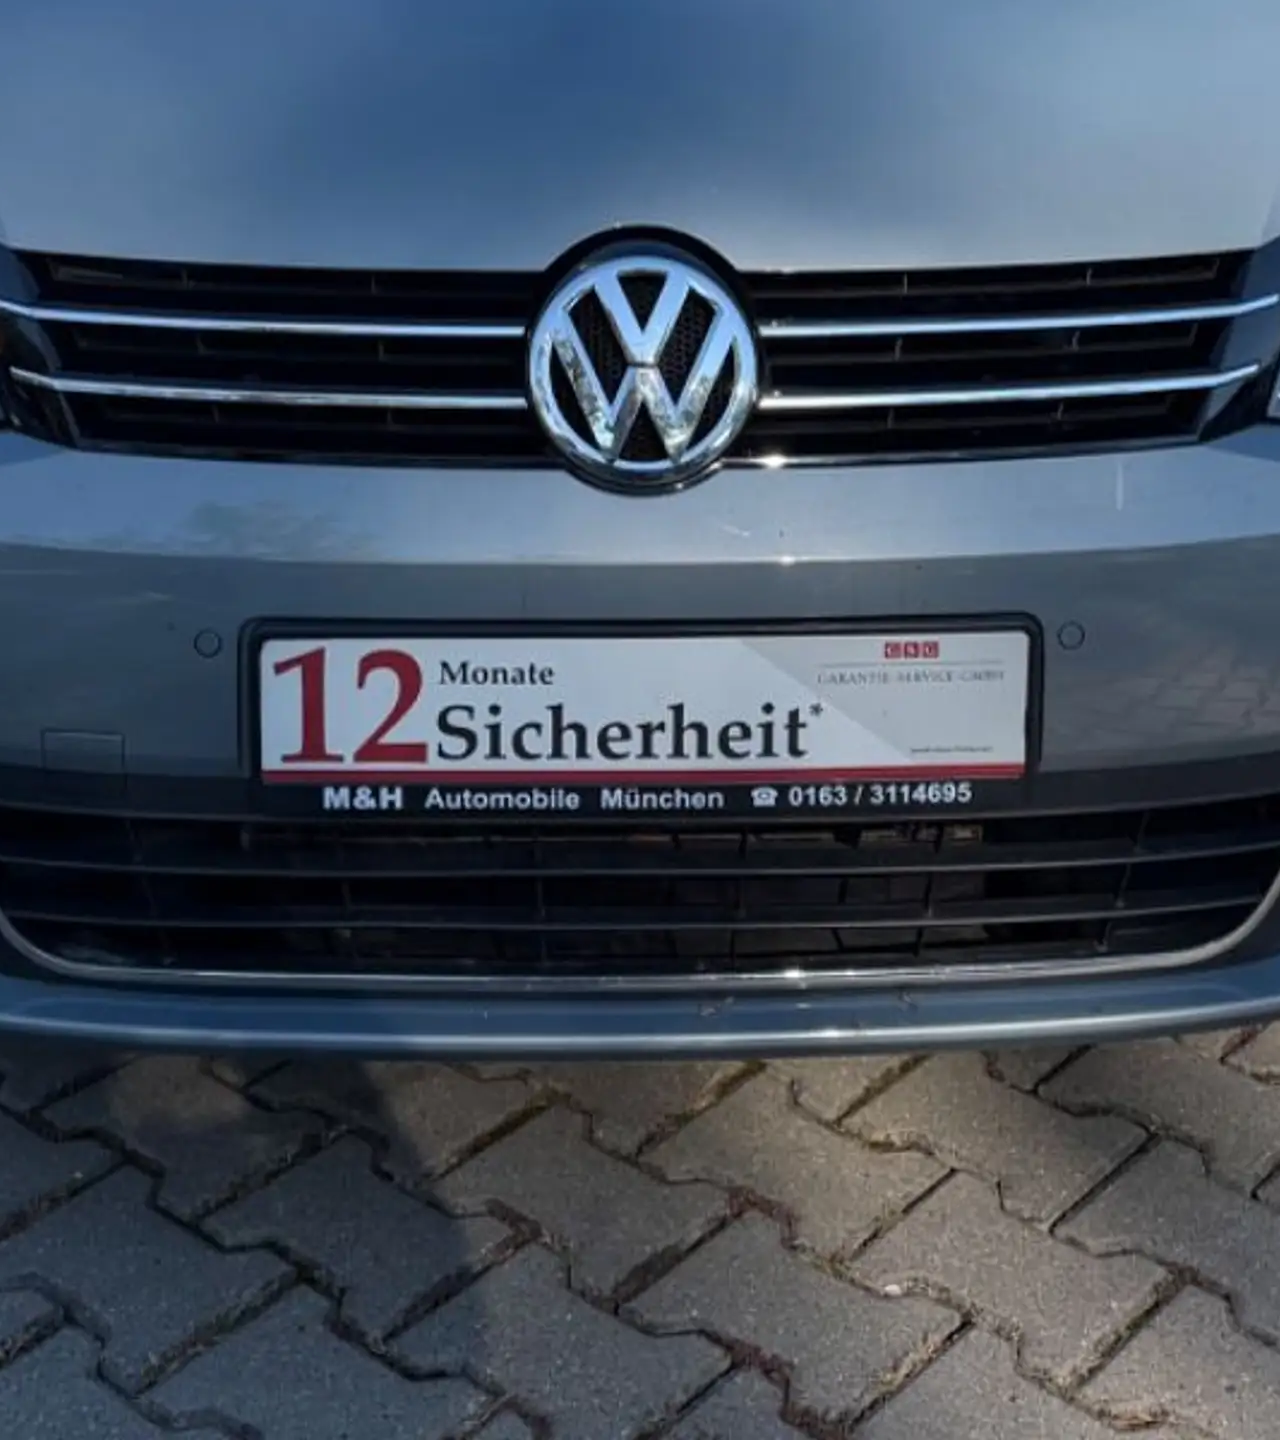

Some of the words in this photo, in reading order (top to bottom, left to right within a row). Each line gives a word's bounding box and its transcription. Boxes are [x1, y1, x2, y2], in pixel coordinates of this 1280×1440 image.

[531, 257, 755, 469] VW
[273, 647, 428, 763] 12
[439, 661, 556, 685] Monate
[323, 786, 403, 810] M&H
[424, 787, 581, 810] Automobile
[600, 786, 724, 810] München
[788, 785, 847, 807] 0163
[870, 782, 973, 804] 3114695
